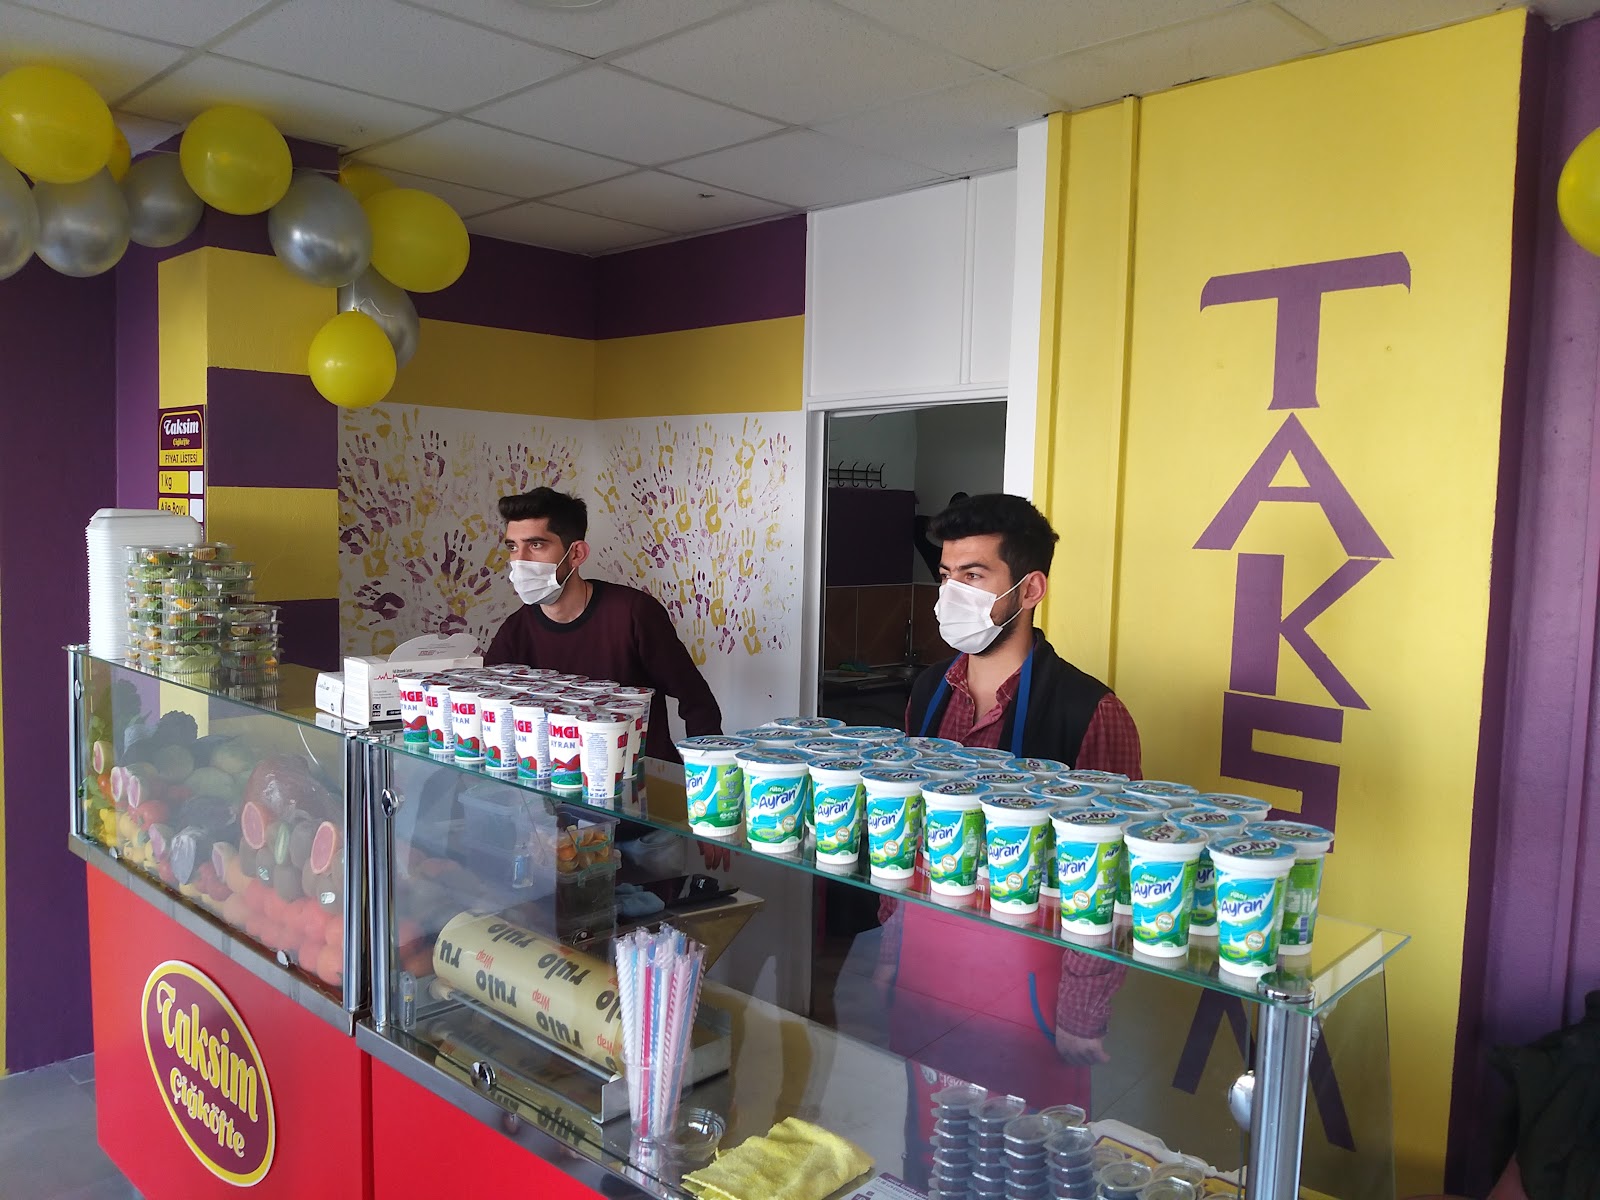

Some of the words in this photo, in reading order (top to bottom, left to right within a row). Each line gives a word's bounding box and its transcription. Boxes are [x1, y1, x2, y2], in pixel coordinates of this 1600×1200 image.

[163, 418, 199, 435] Taksim
[165, 474, 173, 490] kg
[400, 691, 423, 702] MGE
[452, 702, 475, 714] MGE
[551, 741, 575, 749] AYRAN
[686, 777, 703, 791] yran
[759, 788, 796, 809] Ayran
[817, 801, 849, 818] Ayran
[868, 814, 896, 829] Ayran
[988, 843, 1020, 860] Ayran
[1133, 882, 1172, 899] Ayran
[1221, 899, 1263, 917] Ayran
[488, 923, 536, 948] rulo
[438, 939, 463, 968] ru
[476, 949, 495, 970] Wrap
[537, 953, 591, 986] rulo
[475, 969, 517, 1008] rulo
[532, 989, 551, 1011] Wrap
[596, 990, 621, 1023] lo
[536, 1011, 584, 1050] rulo
[157, 980, 258, 1123] Taksim
[597, 1033, 615, 1056] Wrap
[170, 1067, 245, 1158] Çiğköfte
